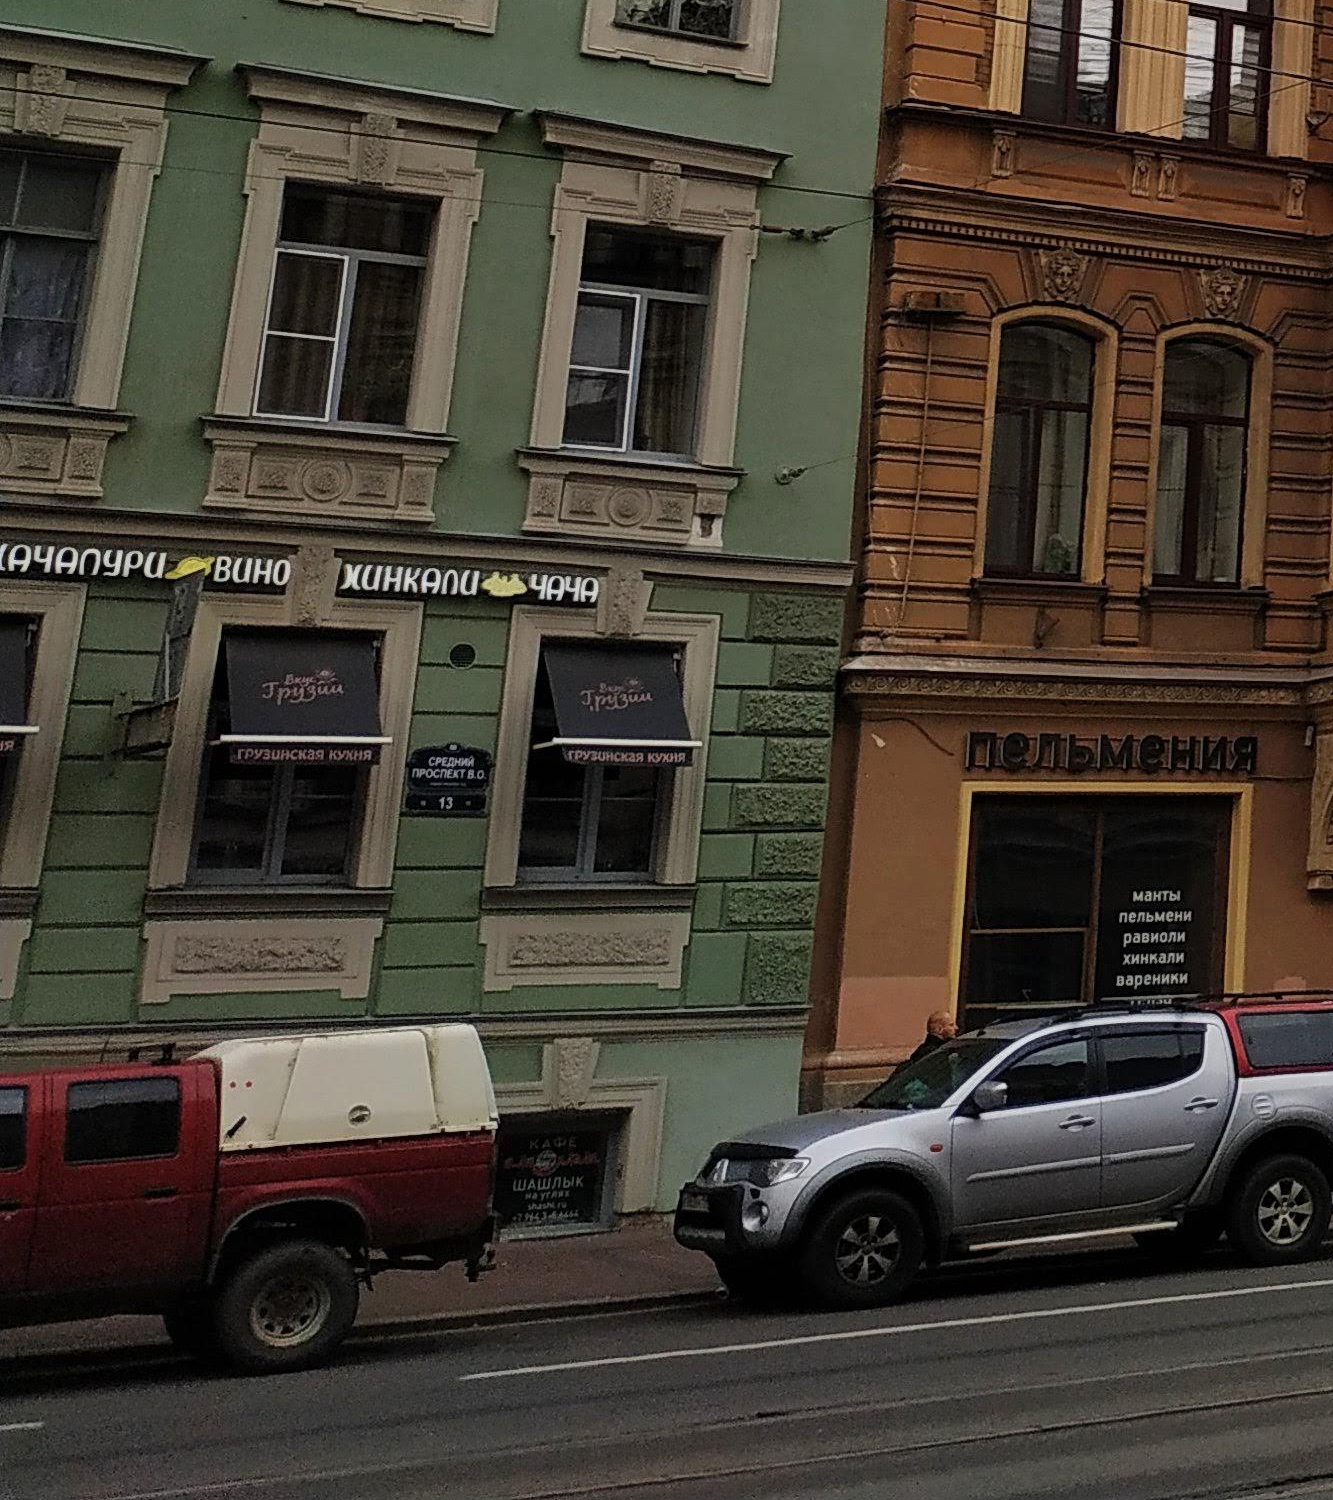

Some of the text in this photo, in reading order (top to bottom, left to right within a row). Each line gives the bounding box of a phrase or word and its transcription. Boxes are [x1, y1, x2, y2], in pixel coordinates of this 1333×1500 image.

[212, 555, 292, 586] ВИНО
[339, 563, 600, 603] ХИНКАЛИ ЧАЧА
[428, 755, 475, 769] СРЕДНИЙ
[412, 767, 466, 780] ПРОСПЕКТ
[439, 796, 453, 809] 13
[1132, 890, 1182, 902] манты
[1119, 910, 1192, 924] пельмени
[1123, 931, 1186, 948] равиоли
[1122, 952, 1185, 965] хинкали
[1116, 972, 1189, 990] вареники
[529, 1137, 577, 1150] КАФЕ
[512, 1176, 584, 1192] ШАШЛЫК
